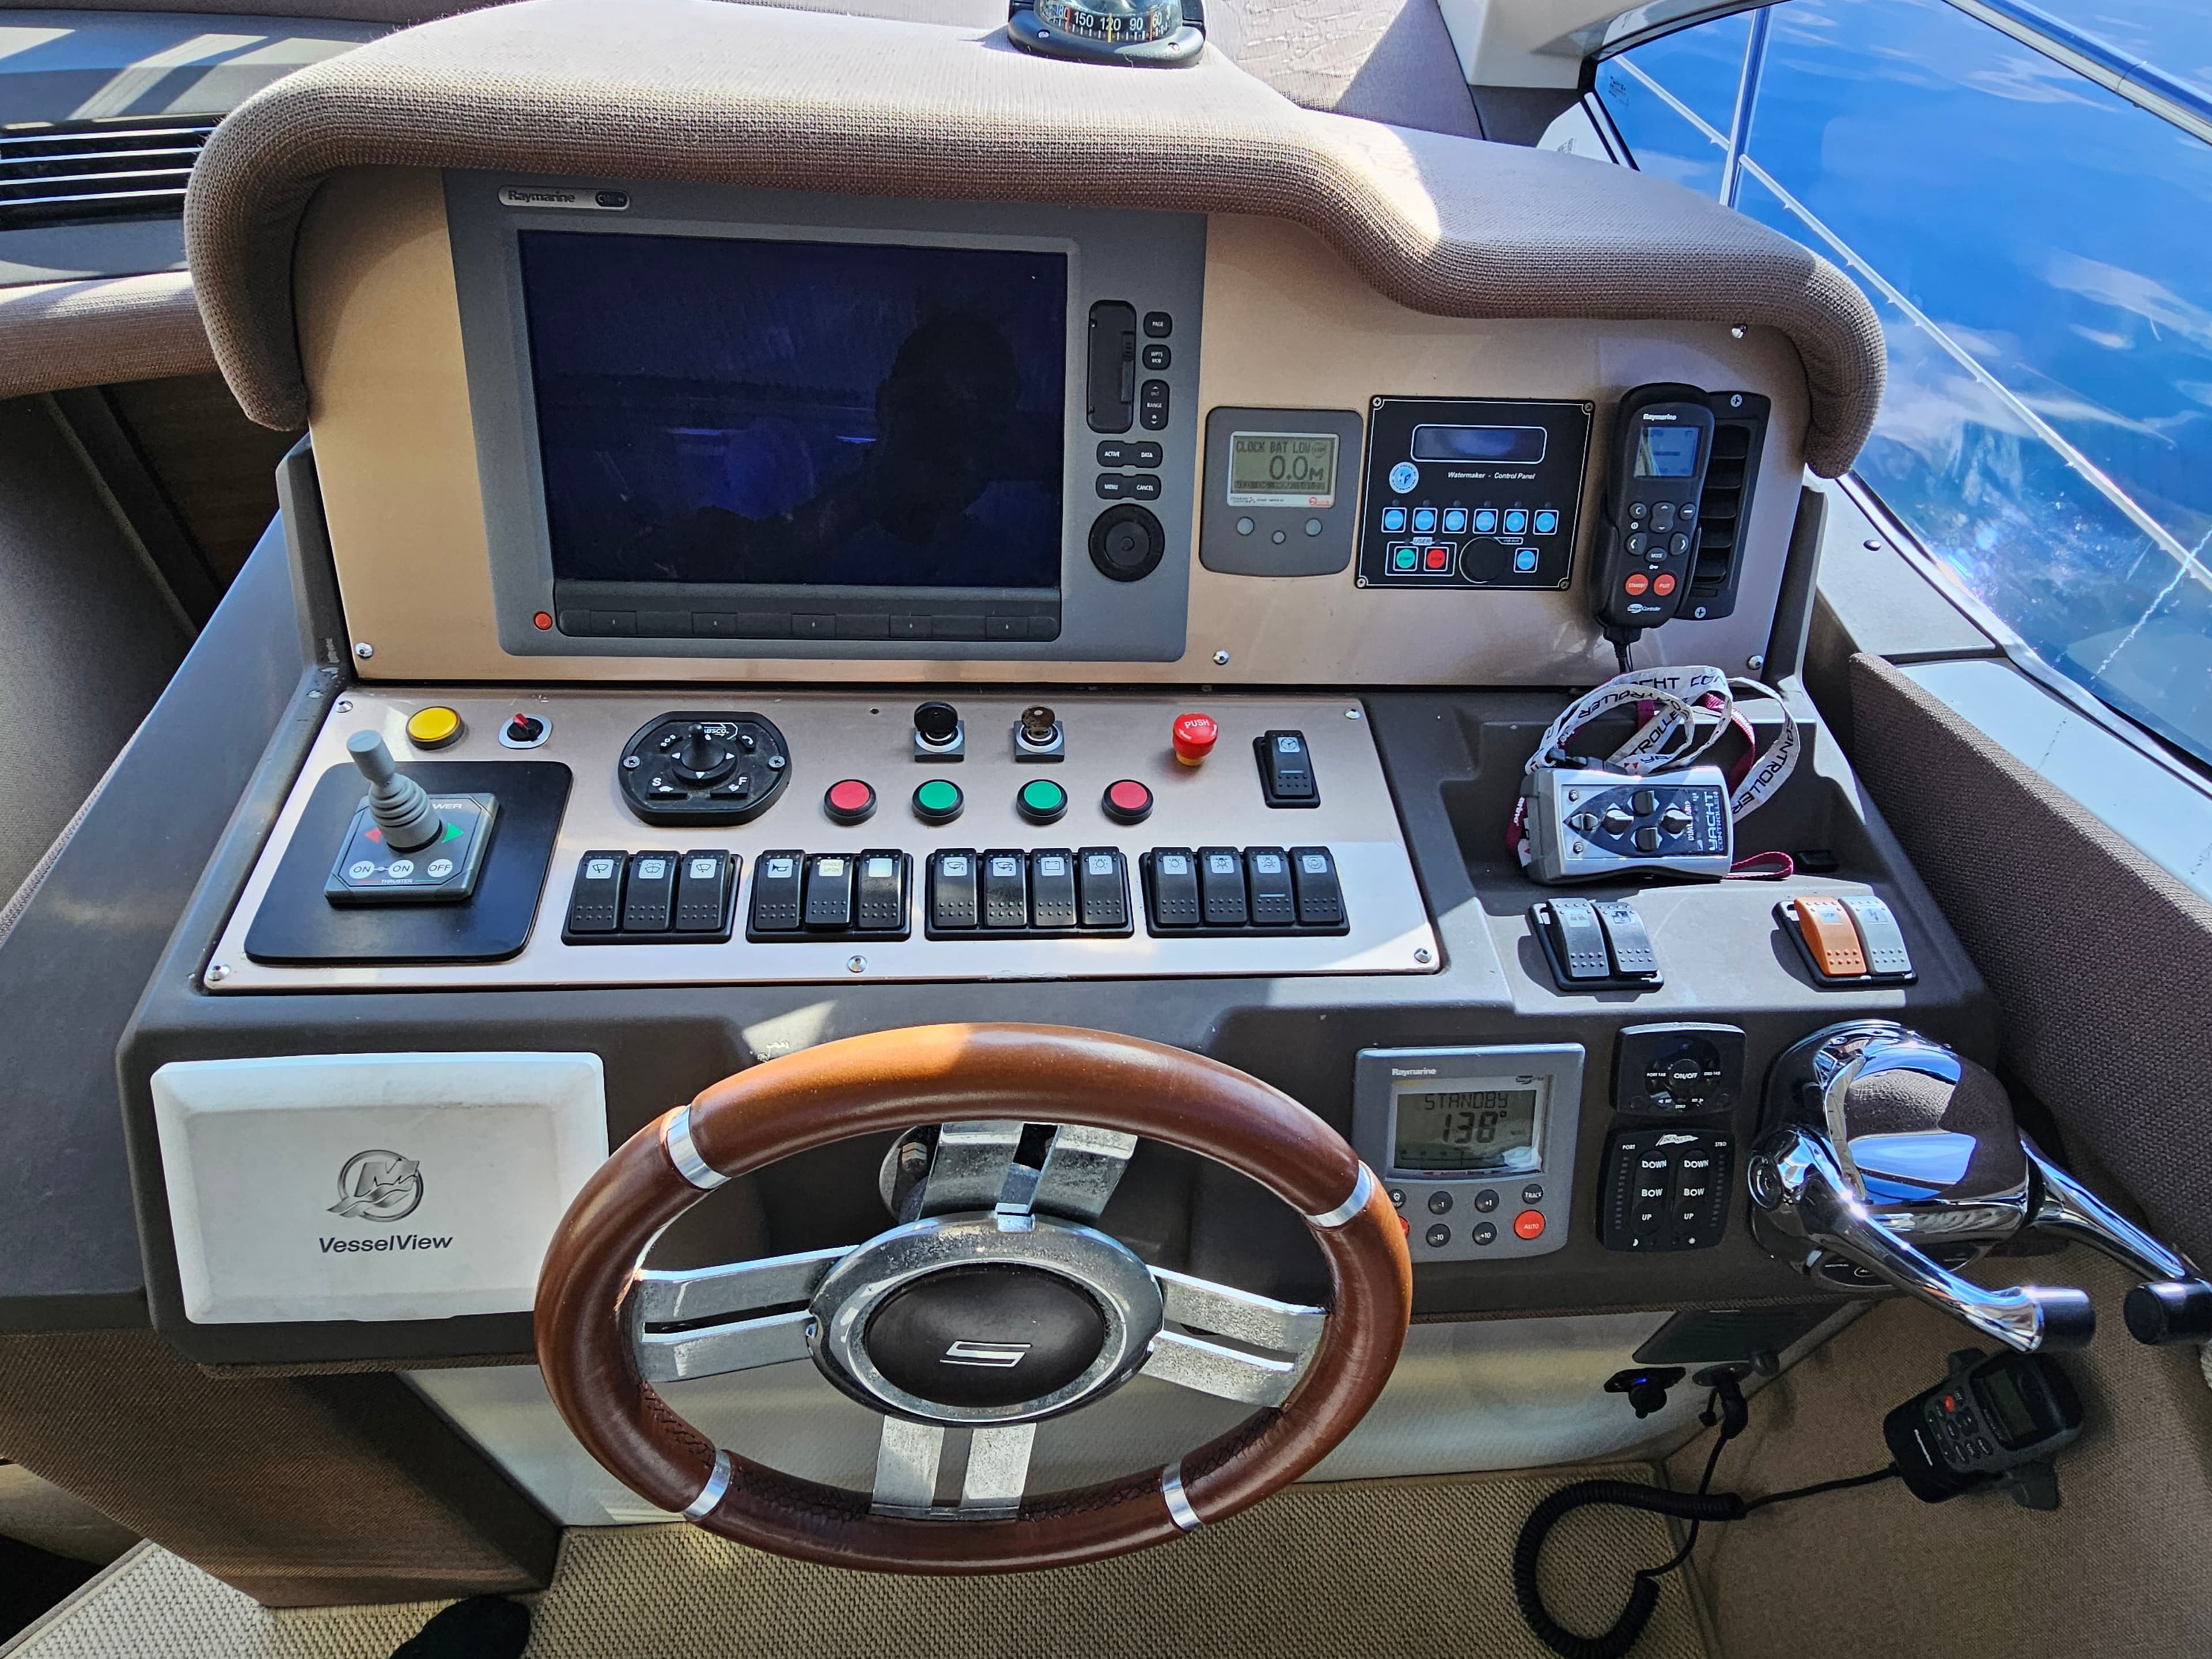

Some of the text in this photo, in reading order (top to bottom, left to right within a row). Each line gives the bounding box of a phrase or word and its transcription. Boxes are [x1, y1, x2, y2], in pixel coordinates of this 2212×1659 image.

[1074, 12, 1094, 28] 150
[1100, 16, 1122, 31] 120
[1129, 17, 1143, 31] 90
[1152, 12, 1162, 26] 60
[507, 190, 575, 203] Raymarine
[1236, 441, 1310, 453] CLOCK BAT LOW
[1184, 718, 1210, 729] PUSH
[652, 778, 662, 787] S
[738, 777, 748, 786] F
[1704, 791, 1718, 851] YACHT
[429, 863, 452, 872] OFF
[1391, 1067, 1437, 1077] Raymarine
[1425, 1091, 1508, 1110] STANDBY
[1642, 1160, 1667, 1169] DOWN
[1684, 1160, 1709, 1169] DOWN
[1641, 1188, 1663, 1198] BOW
[1683, 1187, 1705, 1196] BOW
[319, 1234, 454, 1253] VesselView
